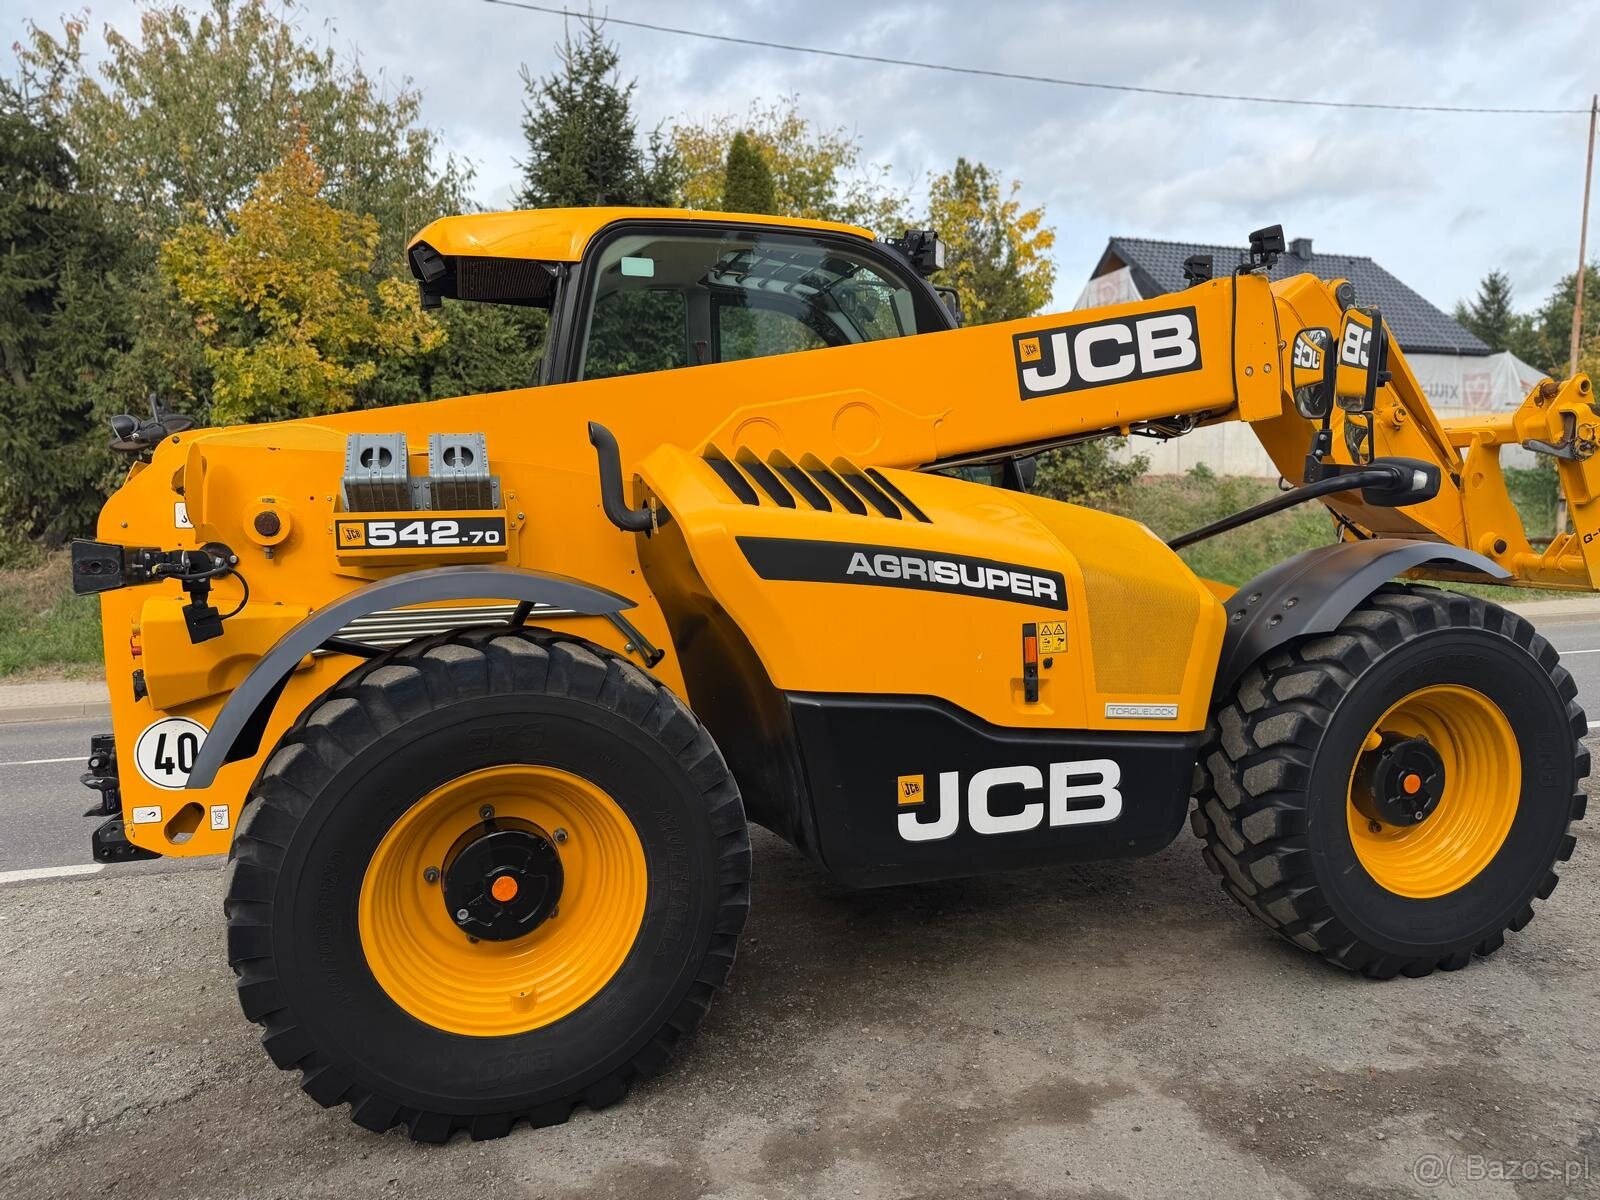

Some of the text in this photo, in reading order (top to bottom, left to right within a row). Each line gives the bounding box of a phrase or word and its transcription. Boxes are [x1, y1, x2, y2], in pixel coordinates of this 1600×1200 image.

[1022, 314, 1197, 392] JCB
[345, 527, 361, 544] JCB
[154, 731, 199, 776] 40
[898, 758, 1123, 842] JCB
[903, 781, 921, 798] JCB
